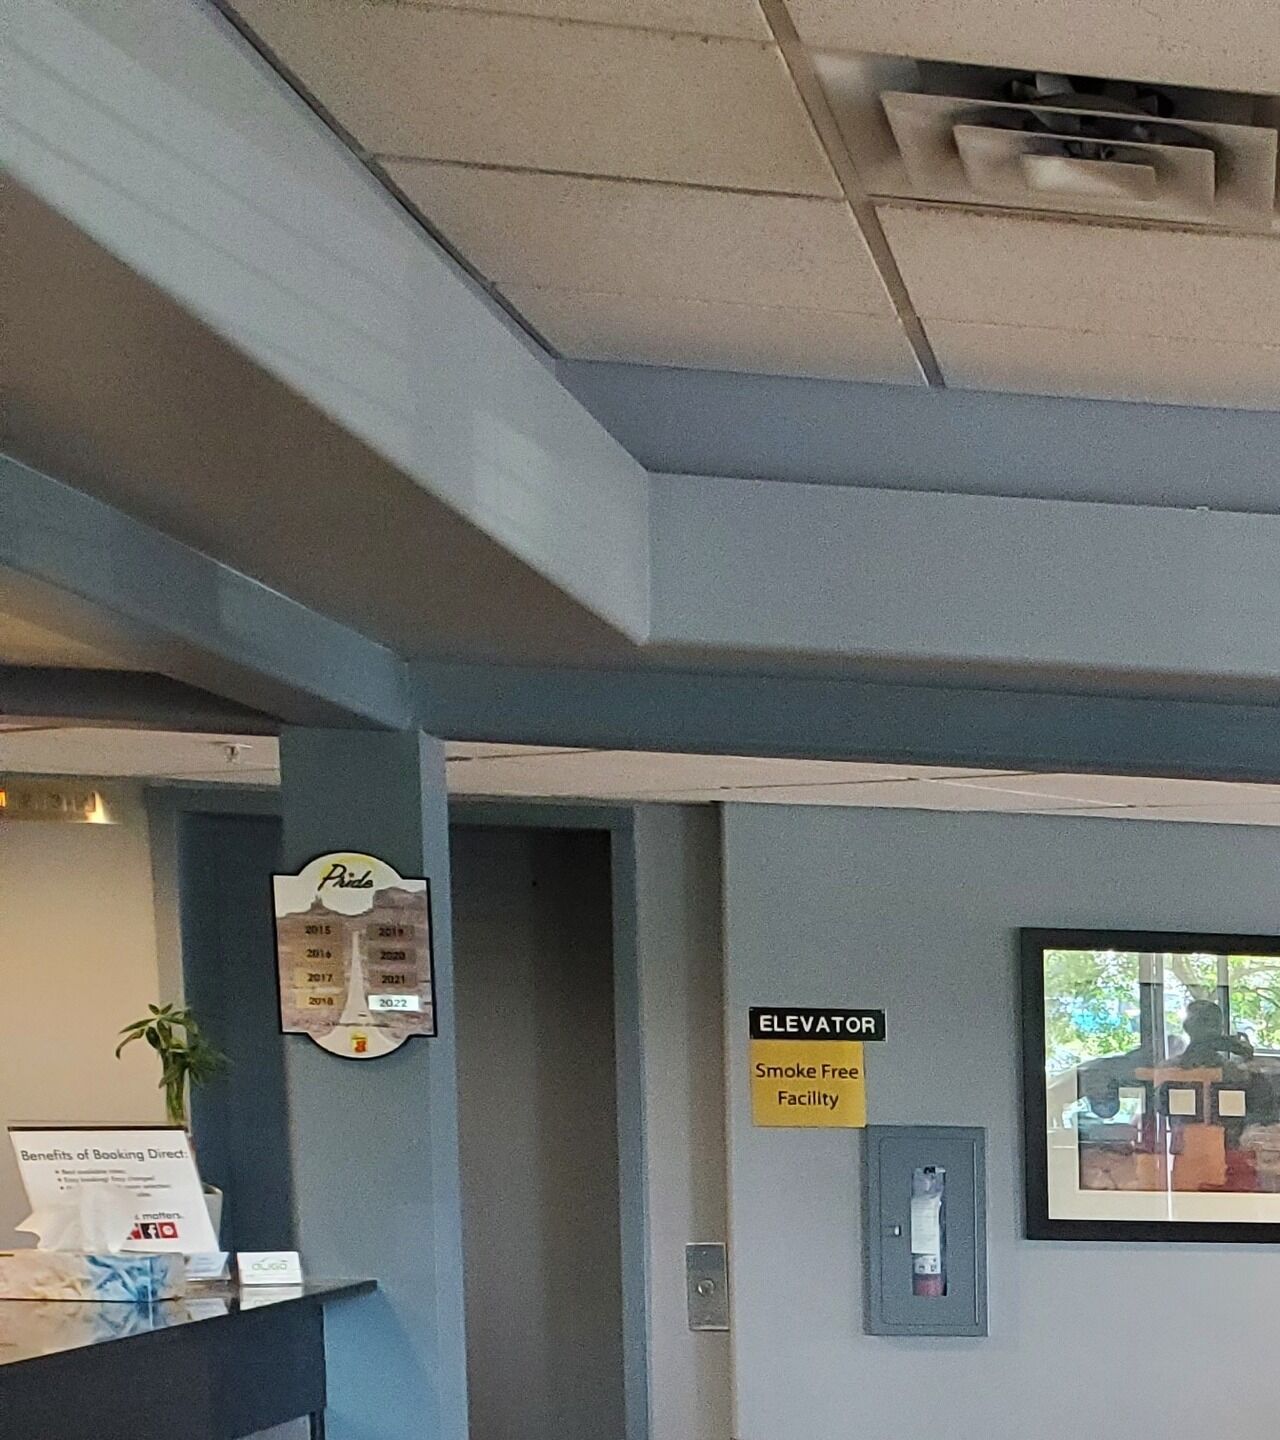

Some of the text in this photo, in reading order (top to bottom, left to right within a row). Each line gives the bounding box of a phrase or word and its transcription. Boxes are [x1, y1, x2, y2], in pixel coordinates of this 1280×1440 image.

[318, 863, 374, 891] Pride
[305, 925, 331, 936] 2015
[306, 949, 332, 959] 2016
[380, 951, 405, 961] 2020
[307, 973, 333, 983] 2017
[381, 975, 405, 984] 2021
[379, 998, 408, 1008] 2022
[759, 1014, 876, 1034] ELEVATOR
[756, 1062, 859, 1079] Smoke Free
[778, 1090, 839, 1110] Facility
[21, 1150, 73, 1161] Benefits
[77, 1149, 91, 1160] of
[94, 1149, 144, 1162] Booking
